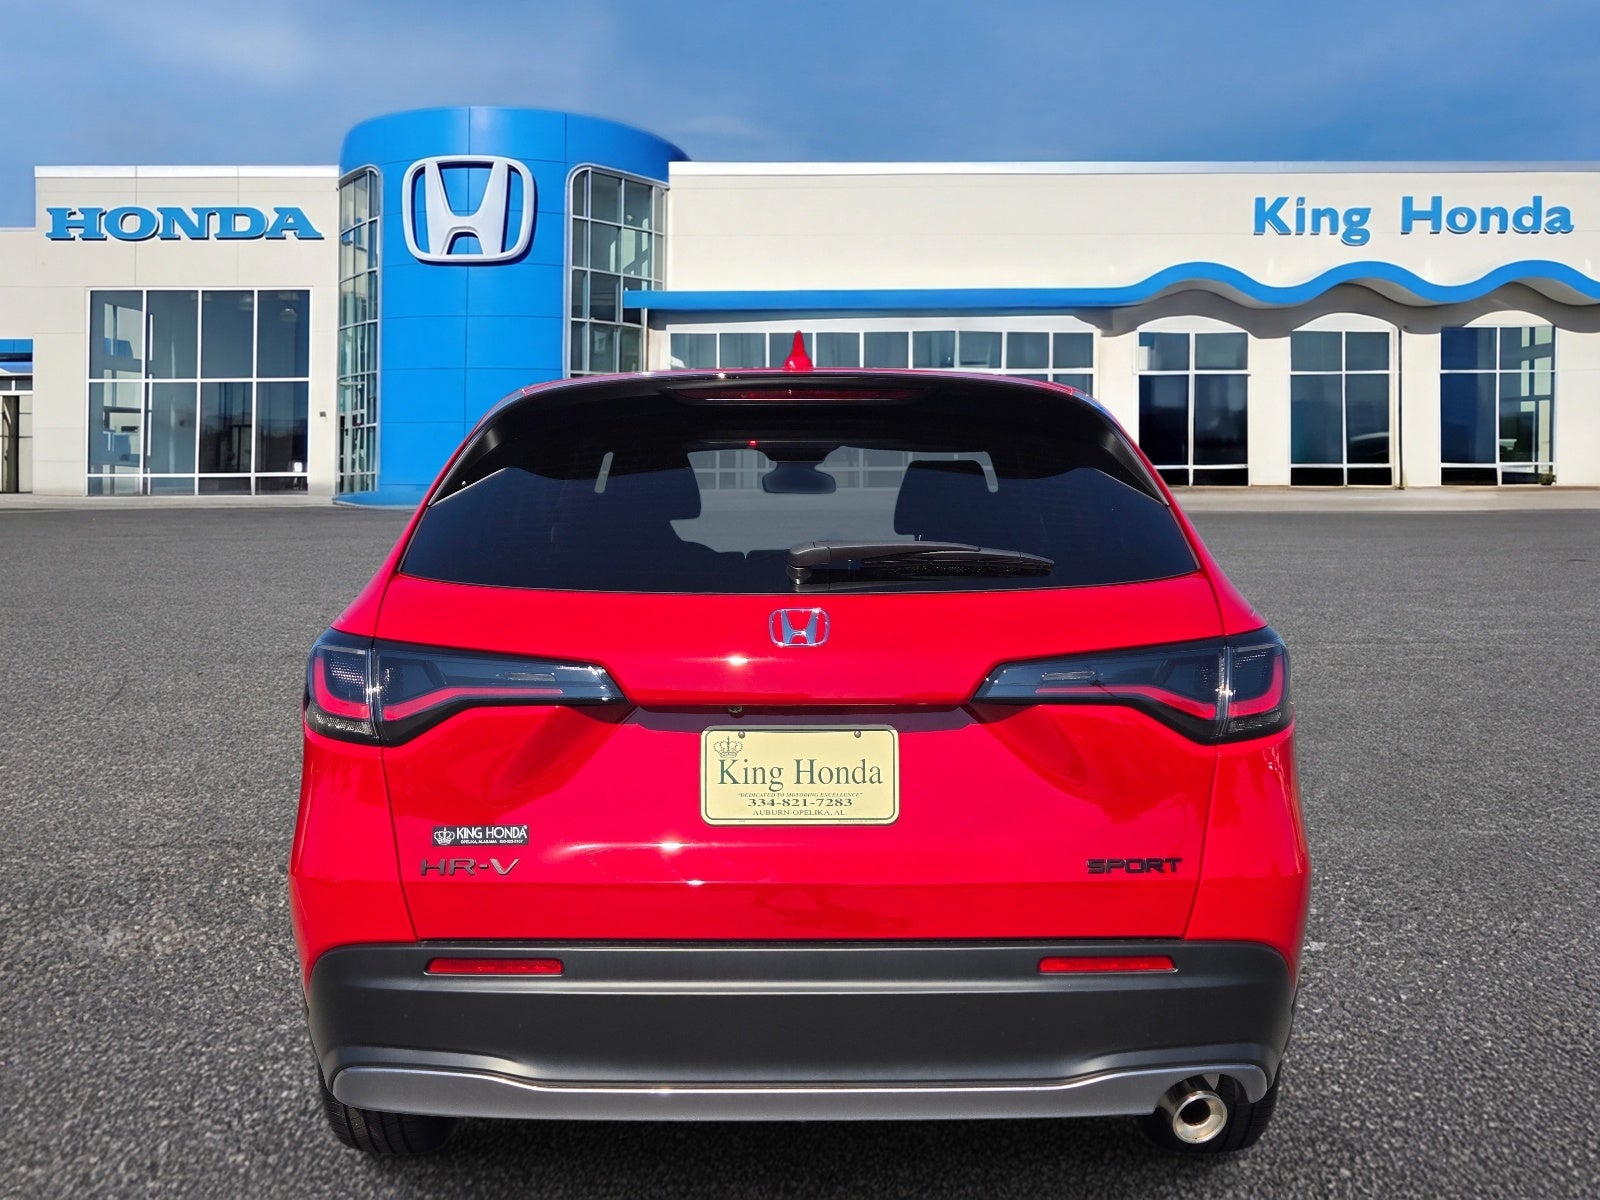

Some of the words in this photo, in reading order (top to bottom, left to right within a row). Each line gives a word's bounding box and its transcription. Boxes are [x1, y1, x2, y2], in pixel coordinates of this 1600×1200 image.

[46, 206, 325, 241] HONDA
[1253, 196, 1372, 246] King
[1400, 195, 1575, 235] Honda
[717, 758, 784, 792] King
[793, 758, 884, 785] Honda
[747, 798, 853, 807] 334-821-7283
[456, 826, 483, 839] KING
[486, 825, 528, 839] HONDA
[421, 858, 520, 876] HR-V
[1086, 857, 1183, 874] SPORT
